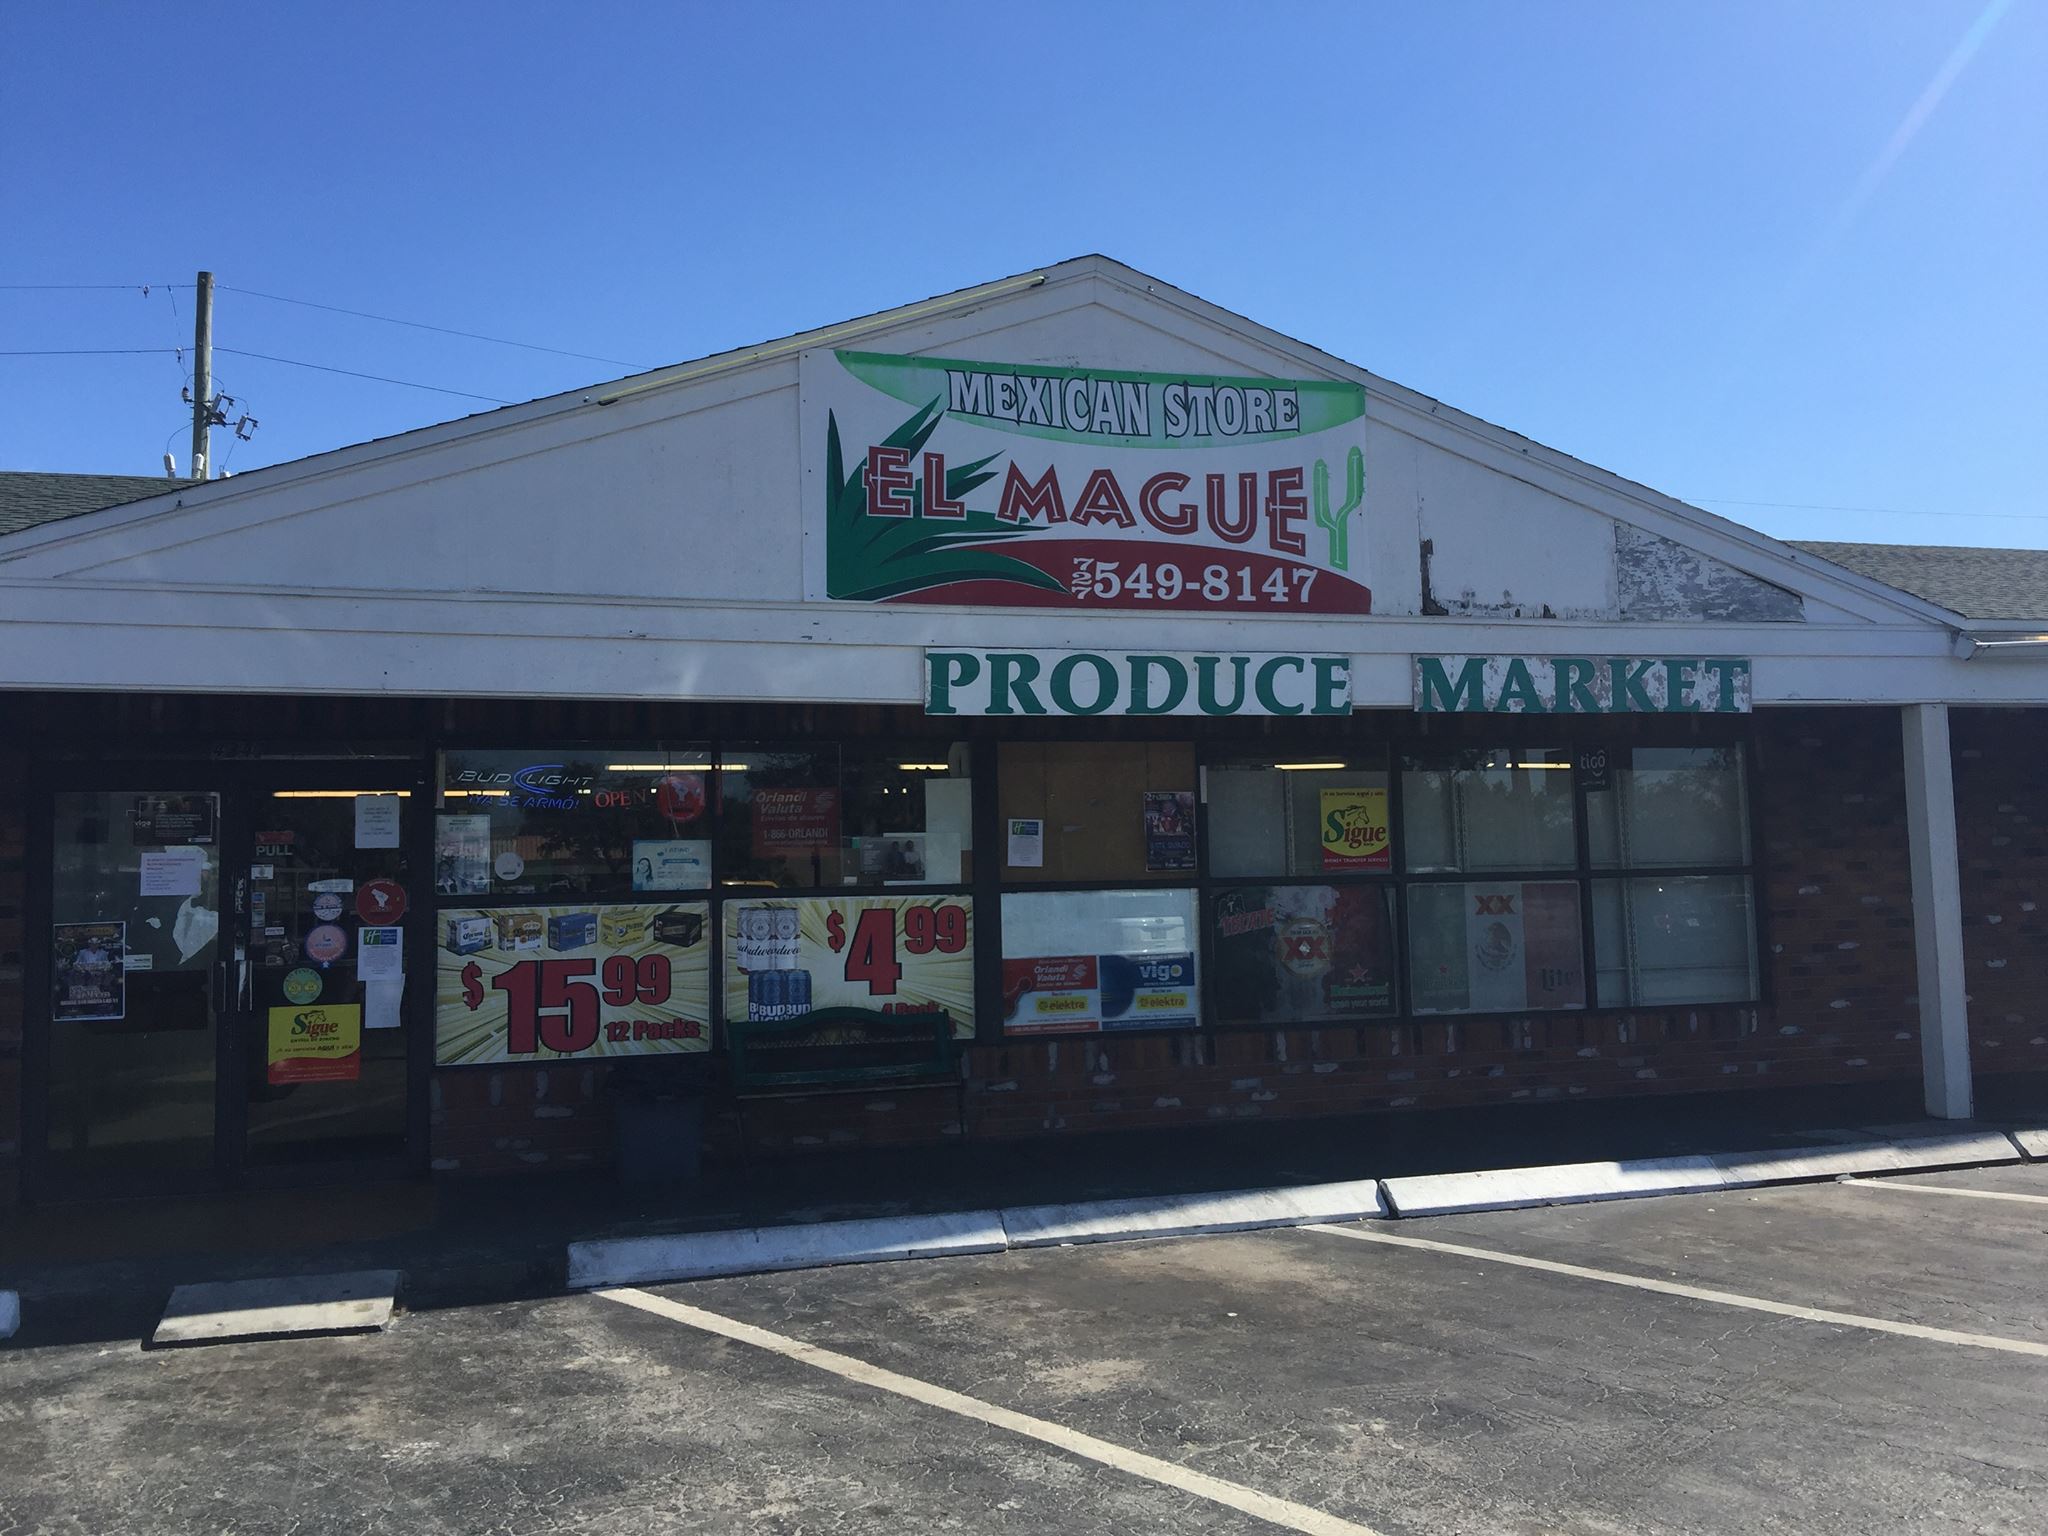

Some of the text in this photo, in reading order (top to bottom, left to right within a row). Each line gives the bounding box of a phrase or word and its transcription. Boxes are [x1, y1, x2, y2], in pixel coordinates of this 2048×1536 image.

[946, 369, 1302, 439] MEXICAN STORE
[862, 445, 967, 519] EL
[1094, 562, 1319, 604] 549-8147
[925, 652, 1351, 715] PRODUCE
[1416, 657, 1749, 713] MARKET
[457, 770, 594, 787] BUD LIGHT
[498, 795, 521, 807] SE
[594, 787, 647, 809] OPEN
[755, 791, 808, 803] Orlandi
[760, 803, 803, 814] Valuta
[1323, 807, 1386, 849] Sigue
[255, 844, 294, 857] PULL
[1139, 961, 1183, 981] vigo
[290, 1011, 339, 1037] Sigue
[604, 1017, 700, 1043] 12 Packs
